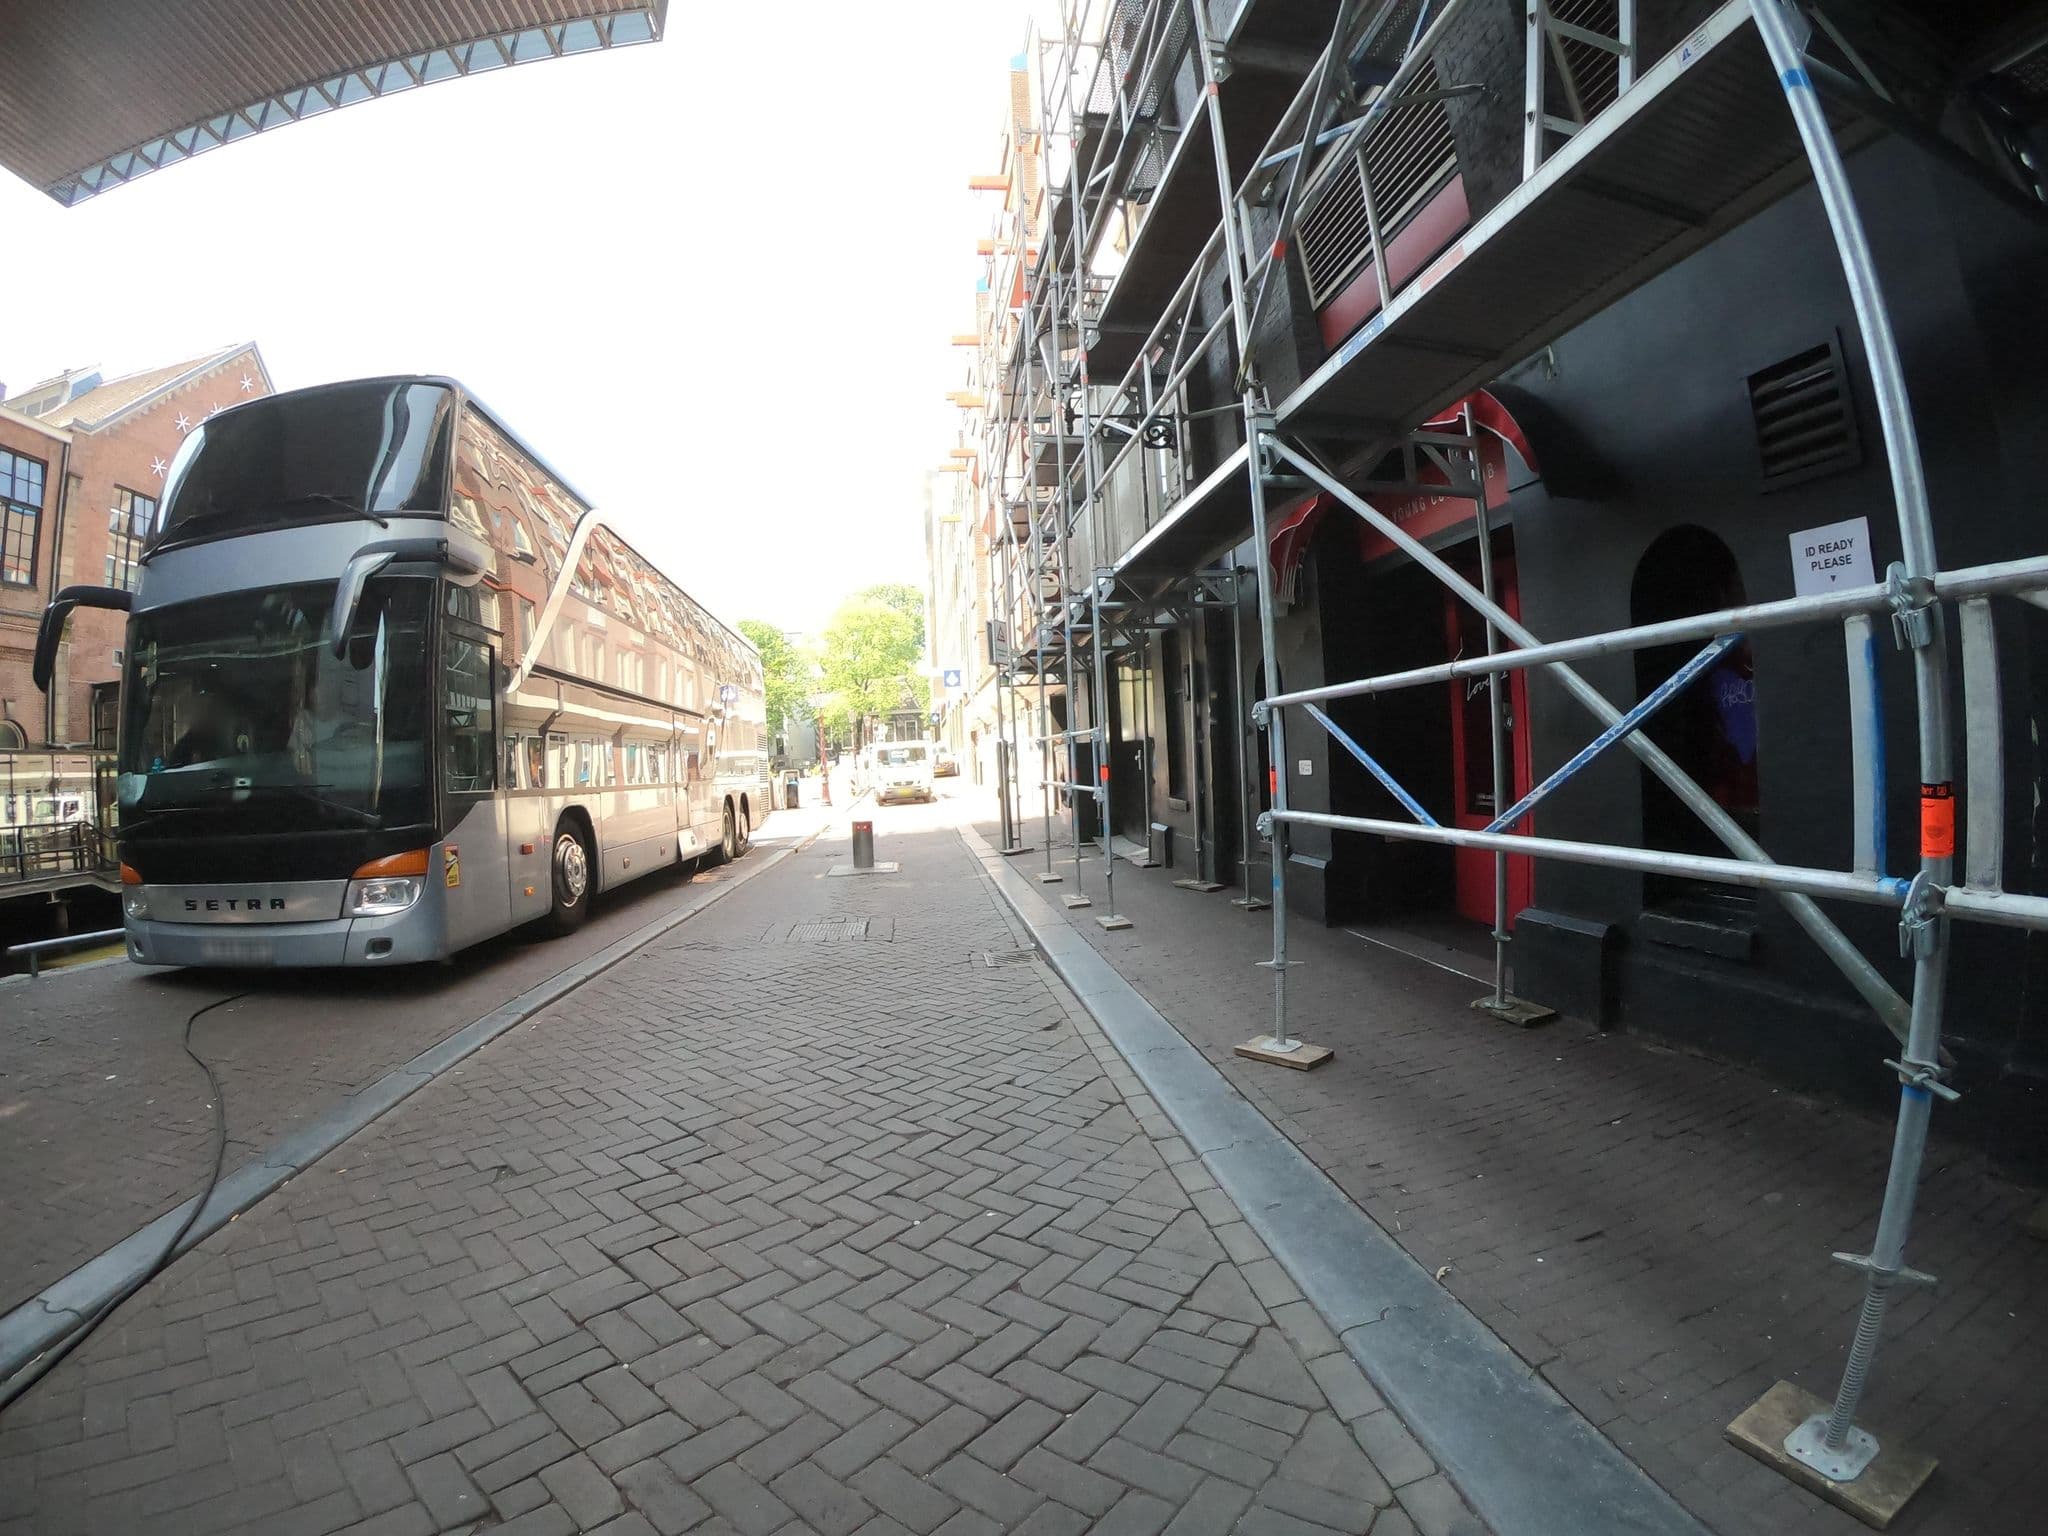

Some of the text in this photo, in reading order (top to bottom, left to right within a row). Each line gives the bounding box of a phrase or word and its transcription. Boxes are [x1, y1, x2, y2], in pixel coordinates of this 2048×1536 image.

[1805, 538, 1854, 557] ID READY
[1811, 554, 1852, 571] PLEASE
[185, 898, 287, 911] SETRA
